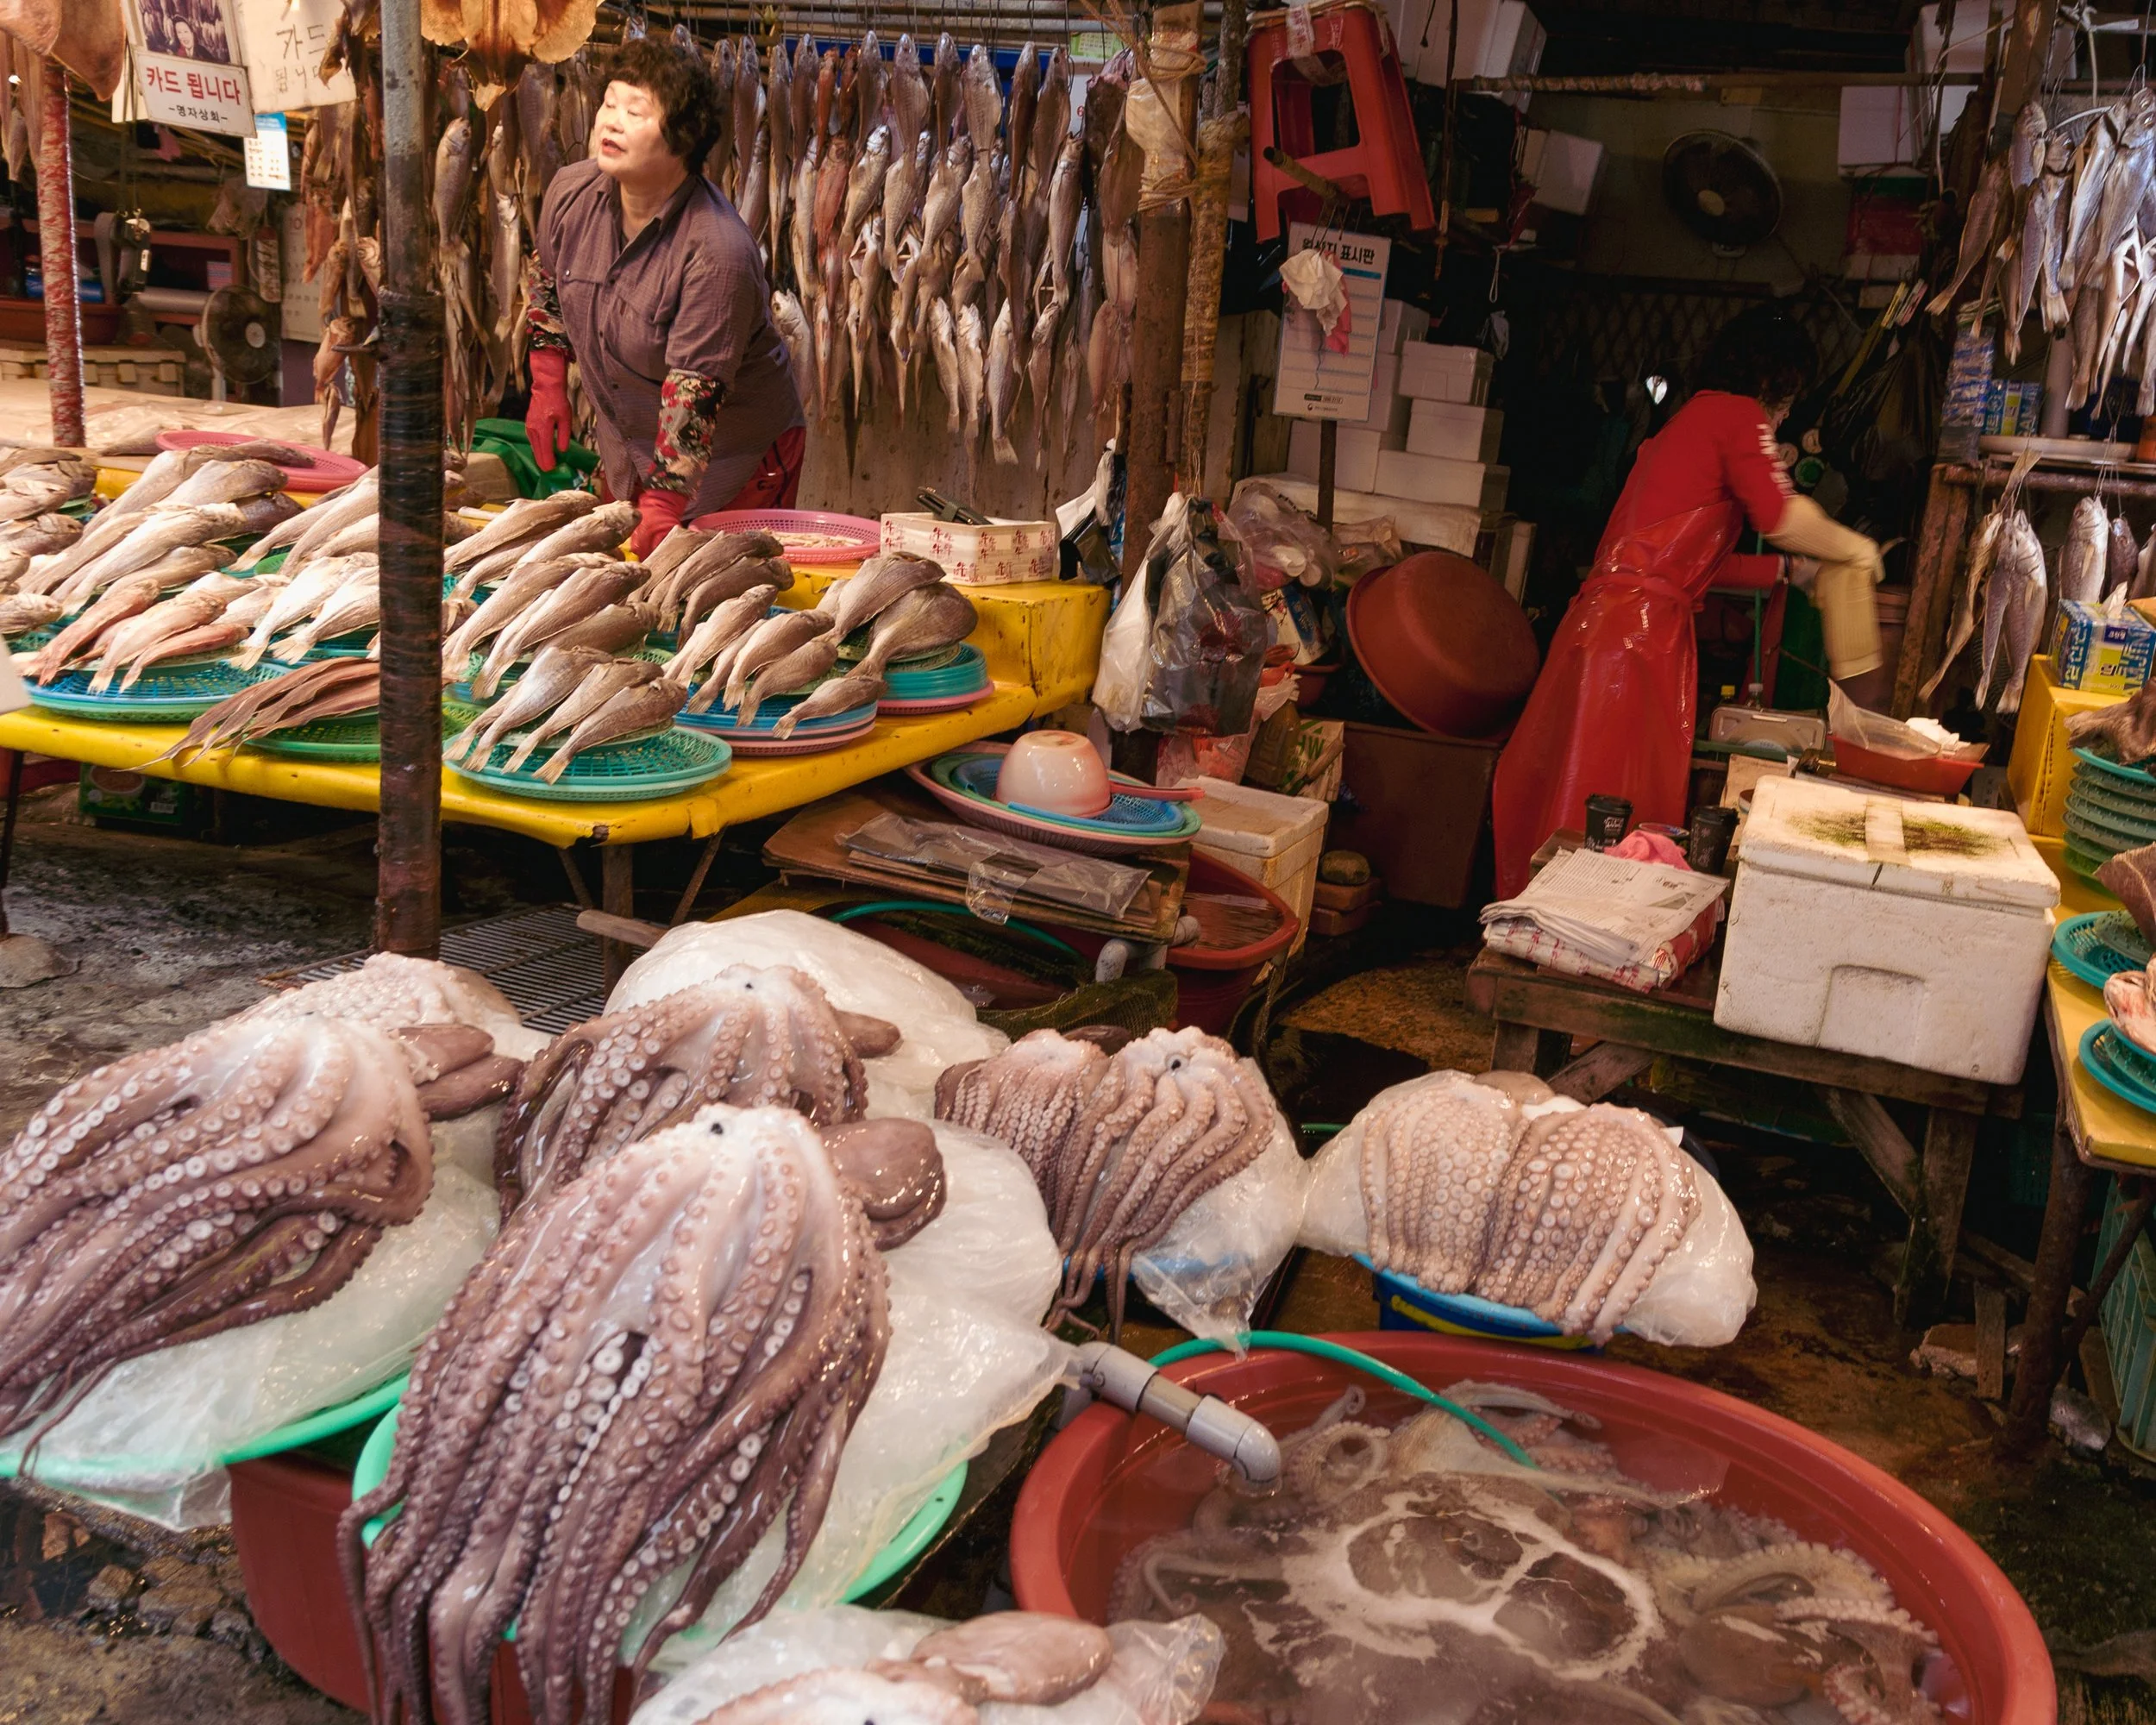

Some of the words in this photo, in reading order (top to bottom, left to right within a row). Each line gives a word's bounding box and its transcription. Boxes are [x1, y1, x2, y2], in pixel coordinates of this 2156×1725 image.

[276, 23, 326, 60] 카드
[146, 66, 182, 93] 카드
[186, 72, 241, 105] 됩니다
[1340, 243, 1376, 266] 표시판
